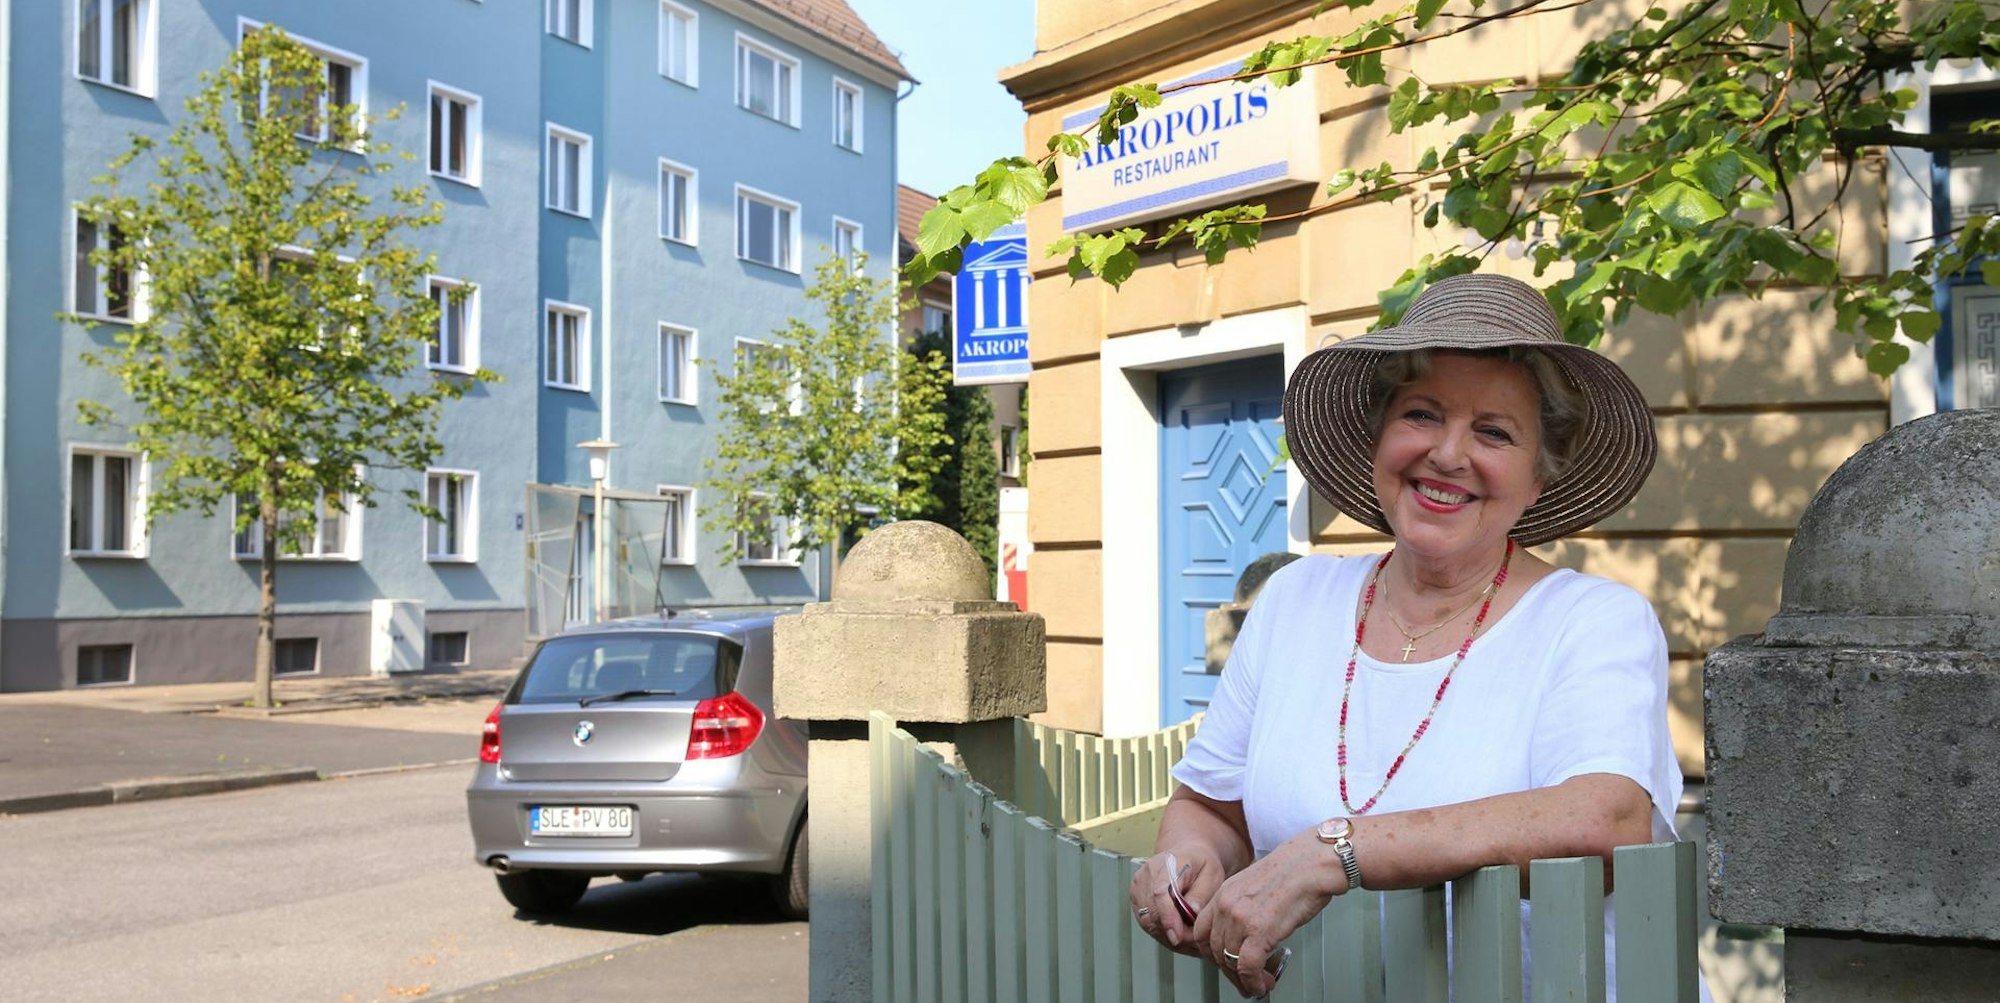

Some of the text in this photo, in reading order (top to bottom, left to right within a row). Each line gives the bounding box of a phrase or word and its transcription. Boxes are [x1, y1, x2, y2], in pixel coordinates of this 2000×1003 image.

[1114, 141, 1220, 186] RESTAURANT
[960, 338, 1029, 357] AKROP
[541, 808, 628, 828] SLE PV 80
